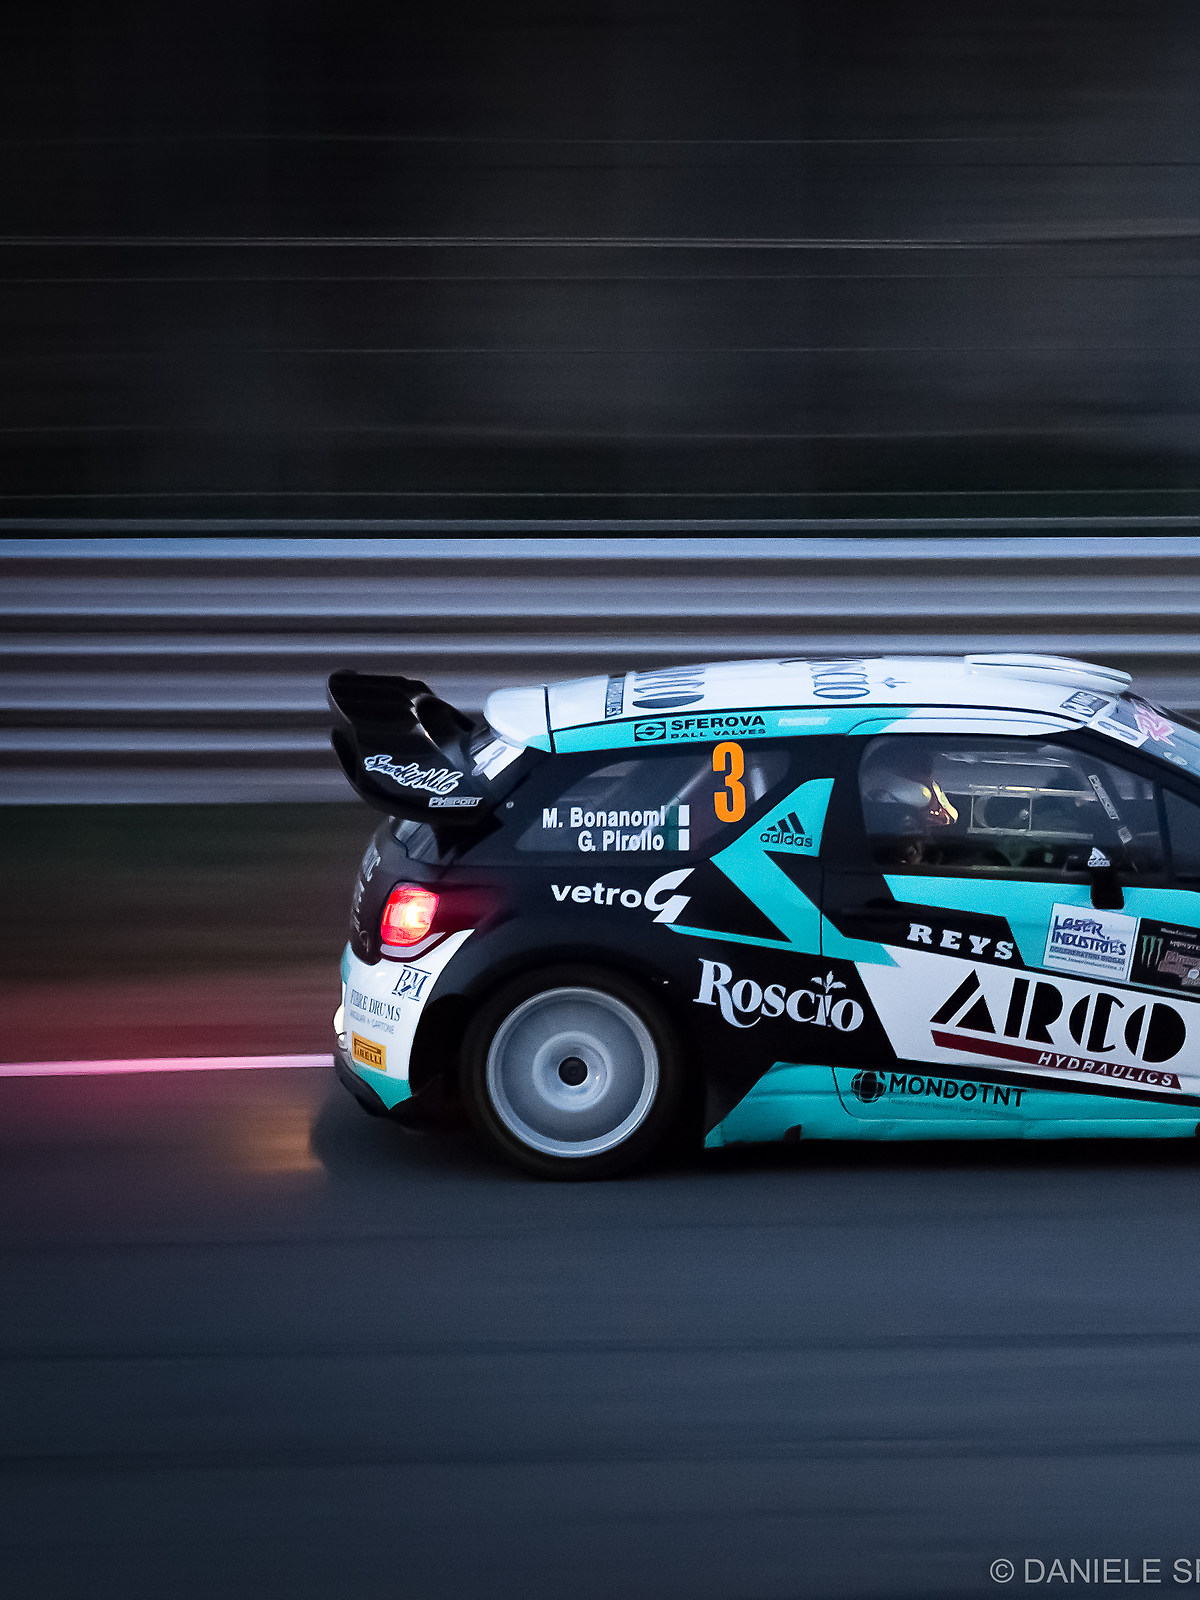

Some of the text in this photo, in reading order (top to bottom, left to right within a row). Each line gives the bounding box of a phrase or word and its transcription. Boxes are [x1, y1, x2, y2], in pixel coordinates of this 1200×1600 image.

[670, 728, 767, 740] BALL VALVES
[671, 715, 766, 731] SFEROVA
[712, 741, 746, 823] 3
[542, 805, 667, 829] M. Bonanomi
[577, 831, 597, 852] G.
[759, 831, 813, 848] adidas
[551, 868, 696, 923] vetroG
[1053, 915, 1106, 939] LASER
[906, 922, 1015, 961] REYS
[1051, 931, 1127, 956] INDUSTRIES
[370, 998, 401, 1022] DRUMS
[929, 969, 1187, 1064] ARCO
[354, 1038, 382, 1065] PIRELLI
[1037, 1051, 1173, 1088] HYDRAULICS
[889, 1073, 1026, 1108] MONDOTNT
